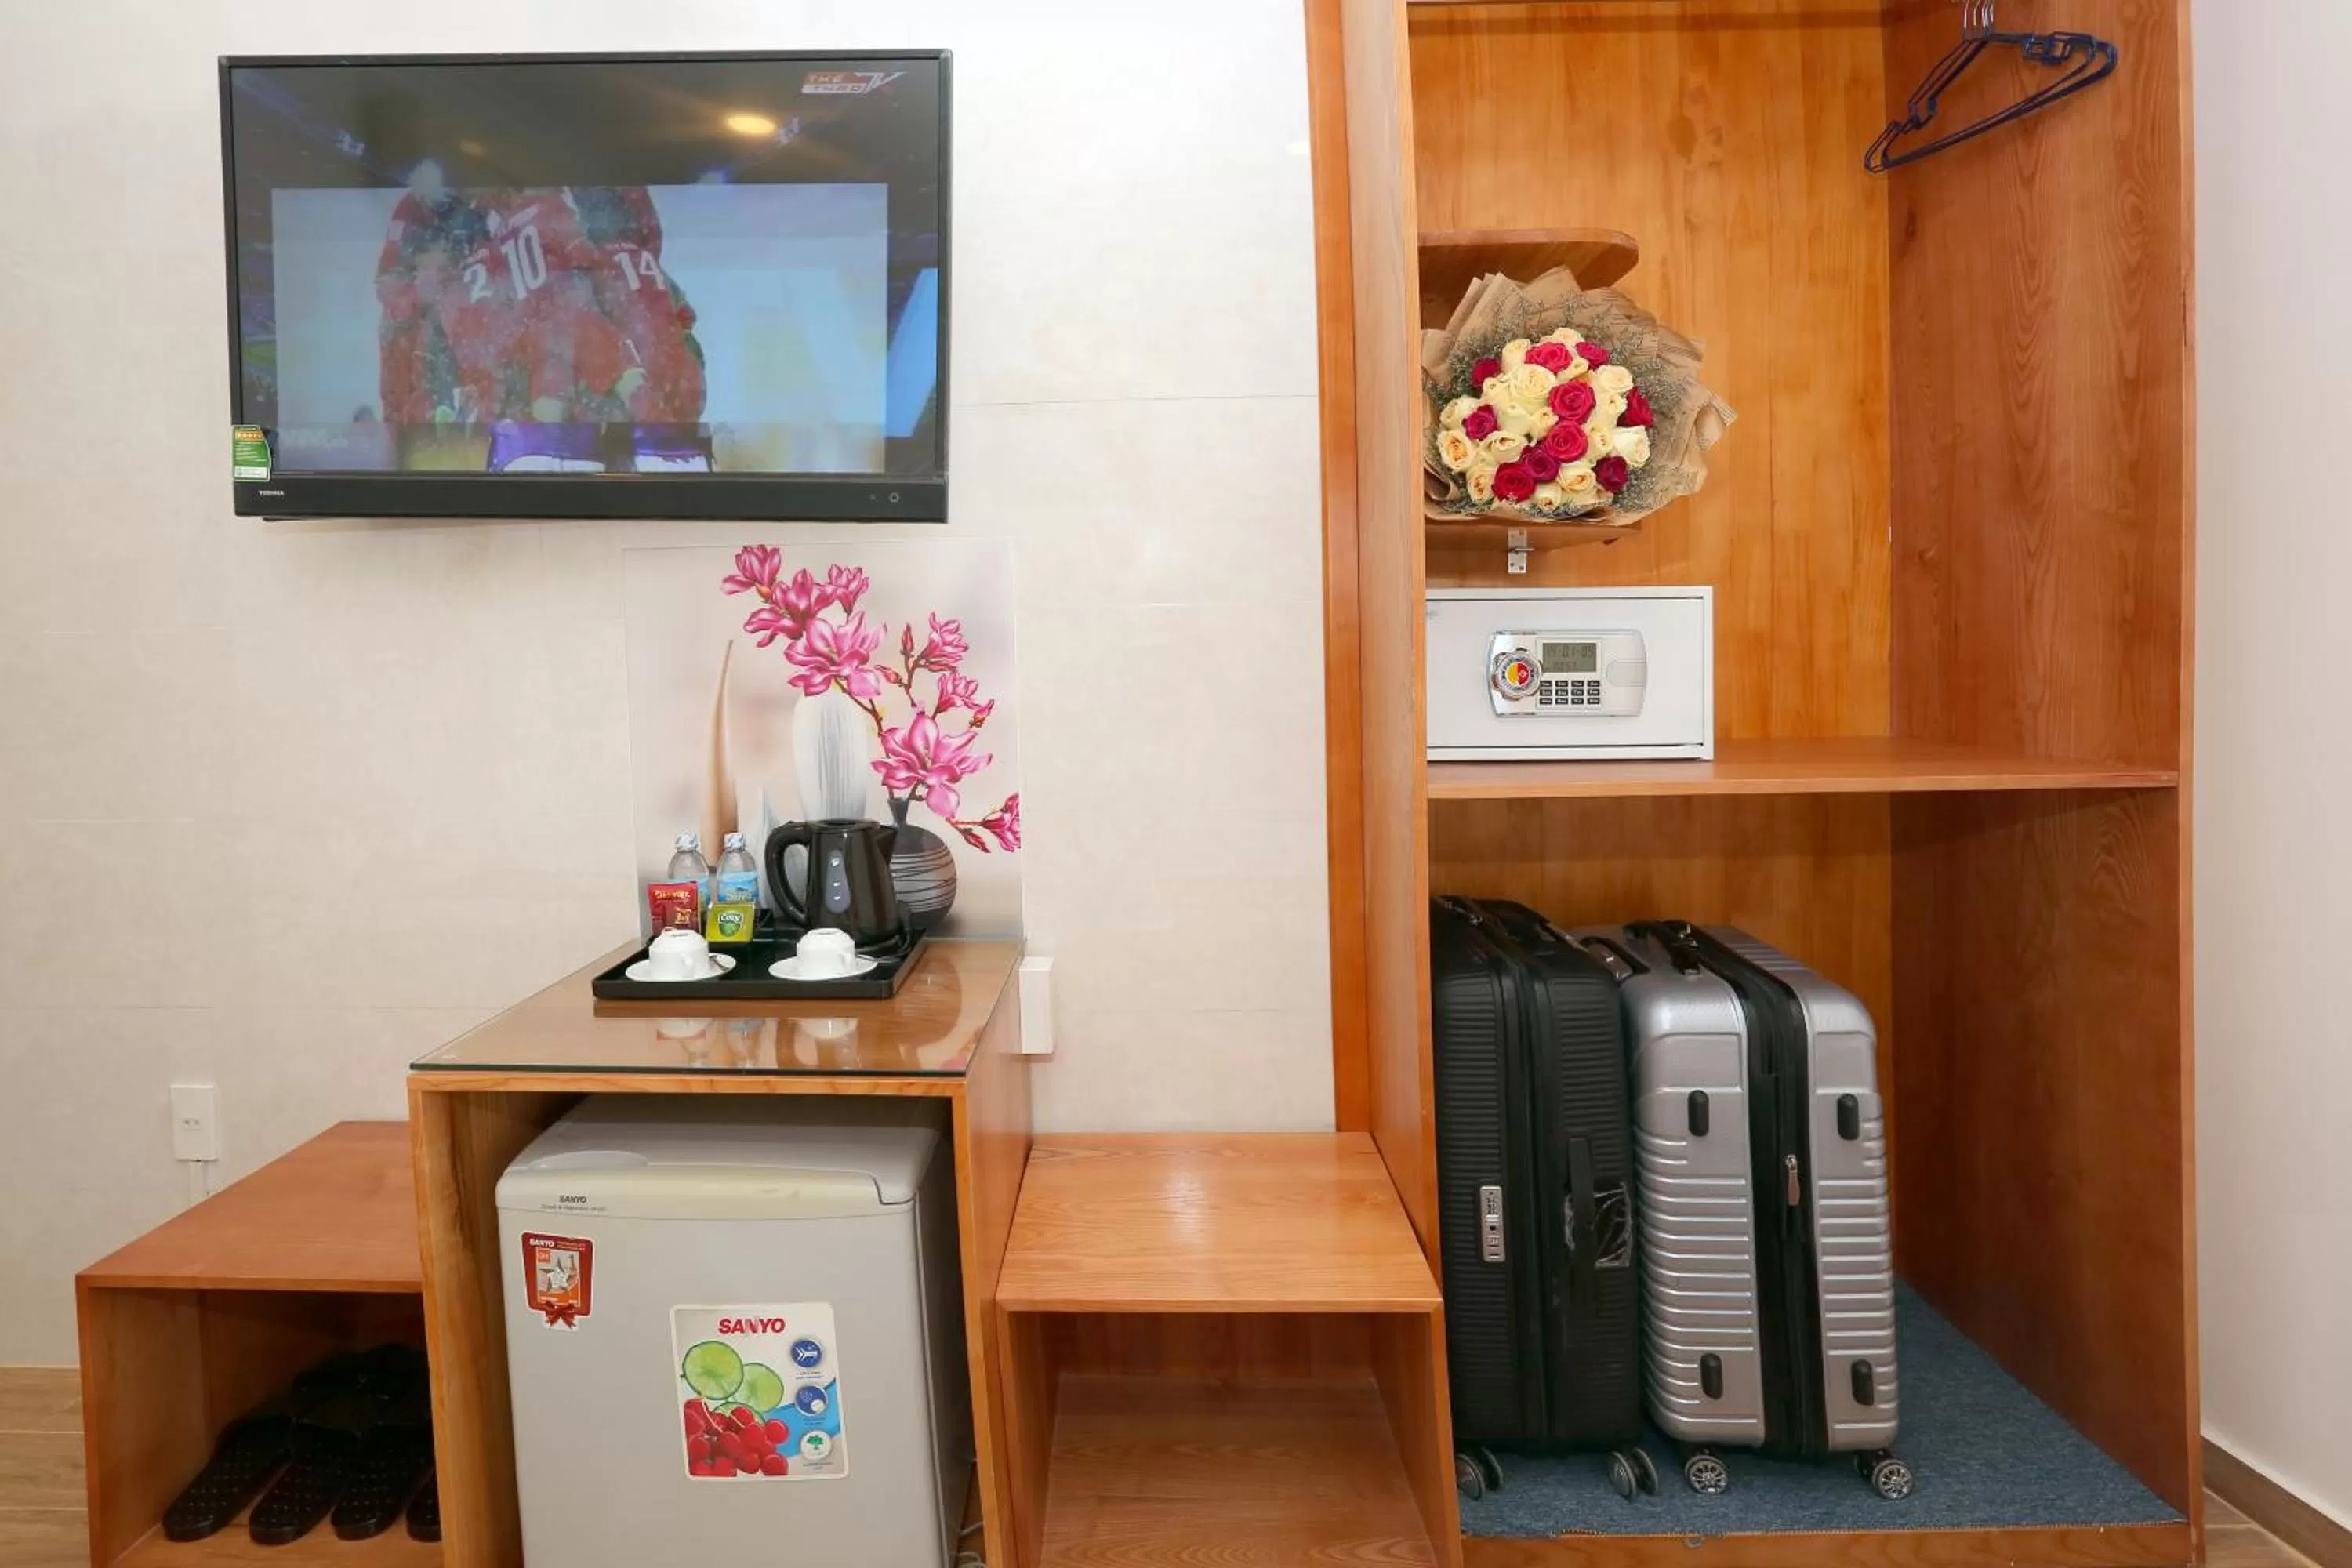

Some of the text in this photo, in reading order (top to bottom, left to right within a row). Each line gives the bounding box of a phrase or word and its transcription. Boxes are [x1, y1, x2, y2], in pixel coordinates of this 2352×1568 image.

[501, 225, 546, 300] 10
[614, 250, 665, 291] 14
[463, 263, 492, 303] 2
[559, 1195, 587, 1203] SANYO
[529, 1238, 554, 1247] SANYO
[718, 1318, 786, 1334] SANYO
